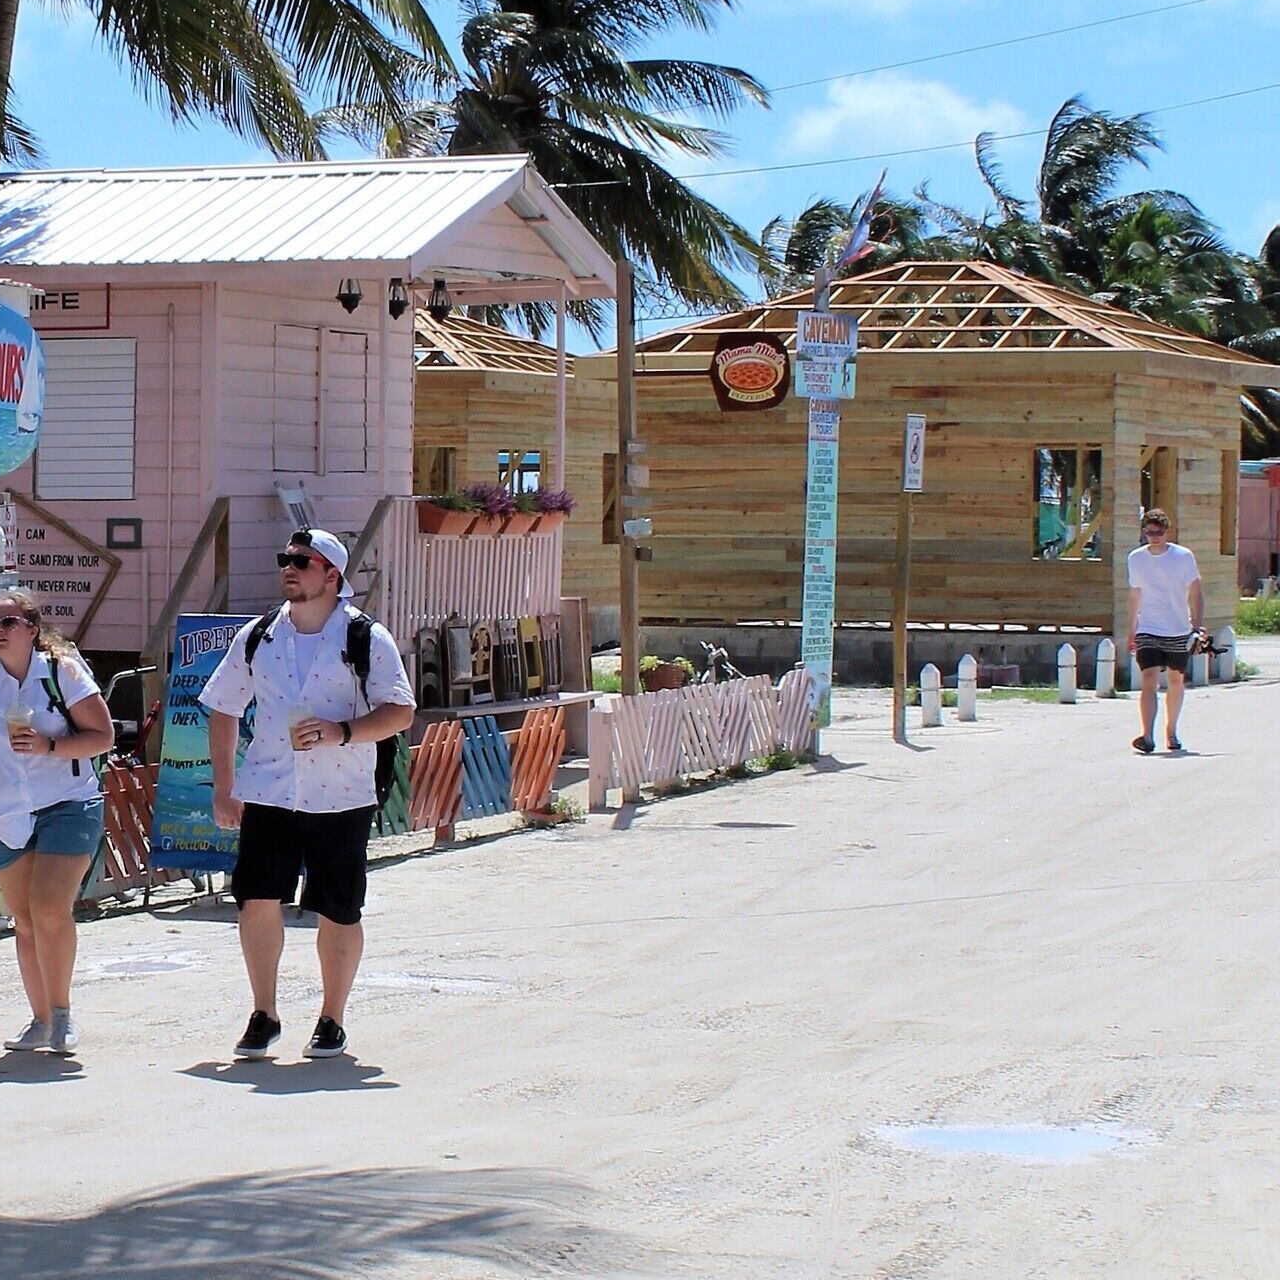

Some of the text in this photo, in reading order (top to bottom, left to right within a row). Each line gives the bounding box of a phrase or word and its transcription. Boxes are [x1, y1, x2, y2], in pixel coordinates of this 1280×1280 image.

[30, 292, 80, 311] IFE
[804, 316, 851, 345] CAVEMAN
[718, 342, 786, 366] Mama Mia's
[731, 390, 774, 402] PIZZERIA
[816, 424, 833, 435] TOURS
[25, 529, 45, 540] CAN
[29, 554, 52, 566] SAND
[52, 555, 74, 567] FROM
[77, 555, 99, 567] YOUR
[37, 580, 65, 592] NEVER
[66, 581, 91, 593] FROM
[55, 606, 75, 617] SOUL
[172, 674, 200, 688] DEEP
[172, 712, 199, 726] OVER
[162, 757, 194, 770] PRIVATE
[175, 838, 210, 851] FOLLOW
